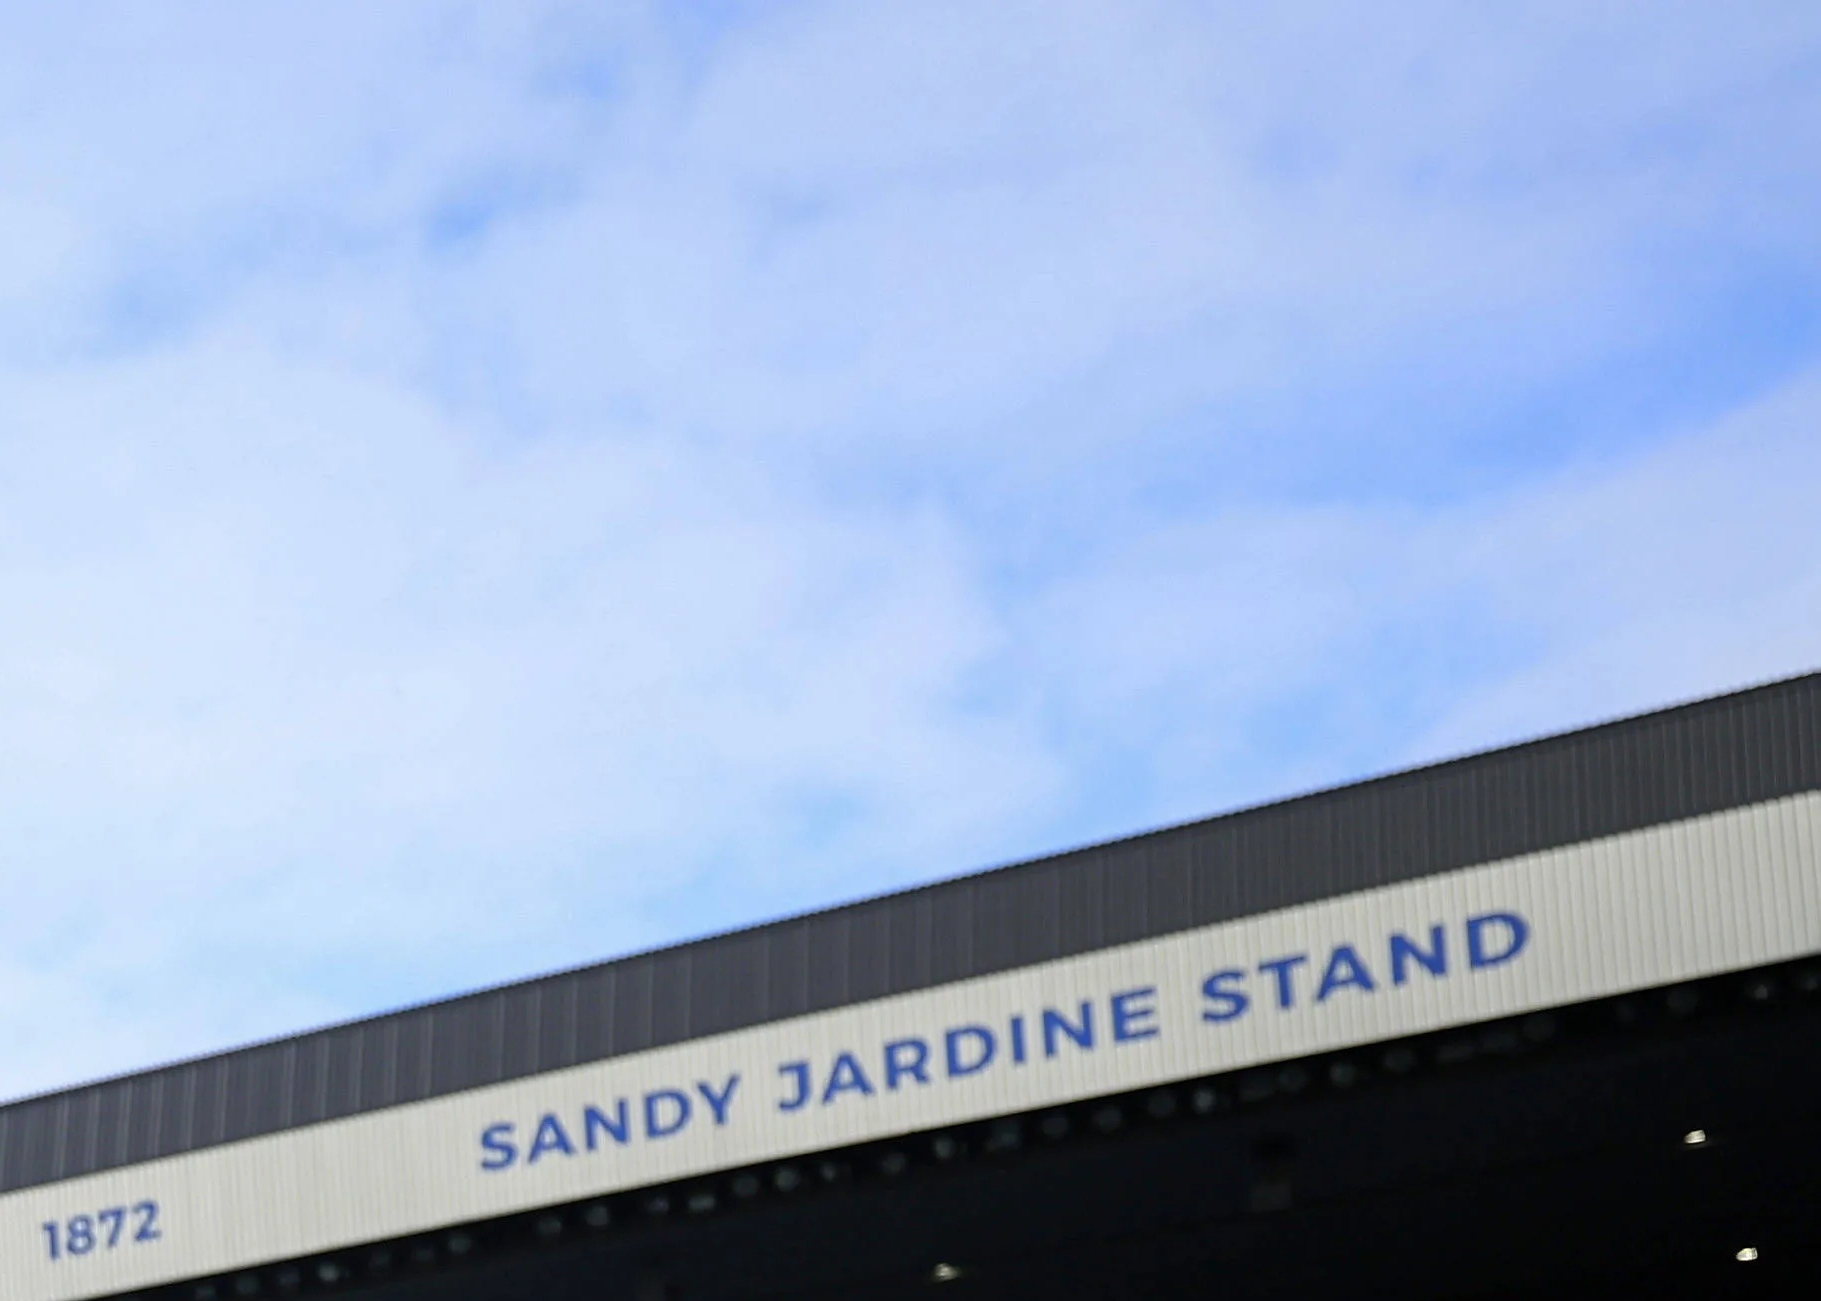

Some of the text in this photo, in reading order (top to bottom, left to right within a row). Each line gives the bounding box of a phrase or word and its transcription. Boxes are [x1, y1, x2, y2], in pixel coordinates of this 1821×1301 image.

[479, 910, 1531, 1172] SANDY JARDINE STAND
[42, 1199, 164, 1262] 1872
